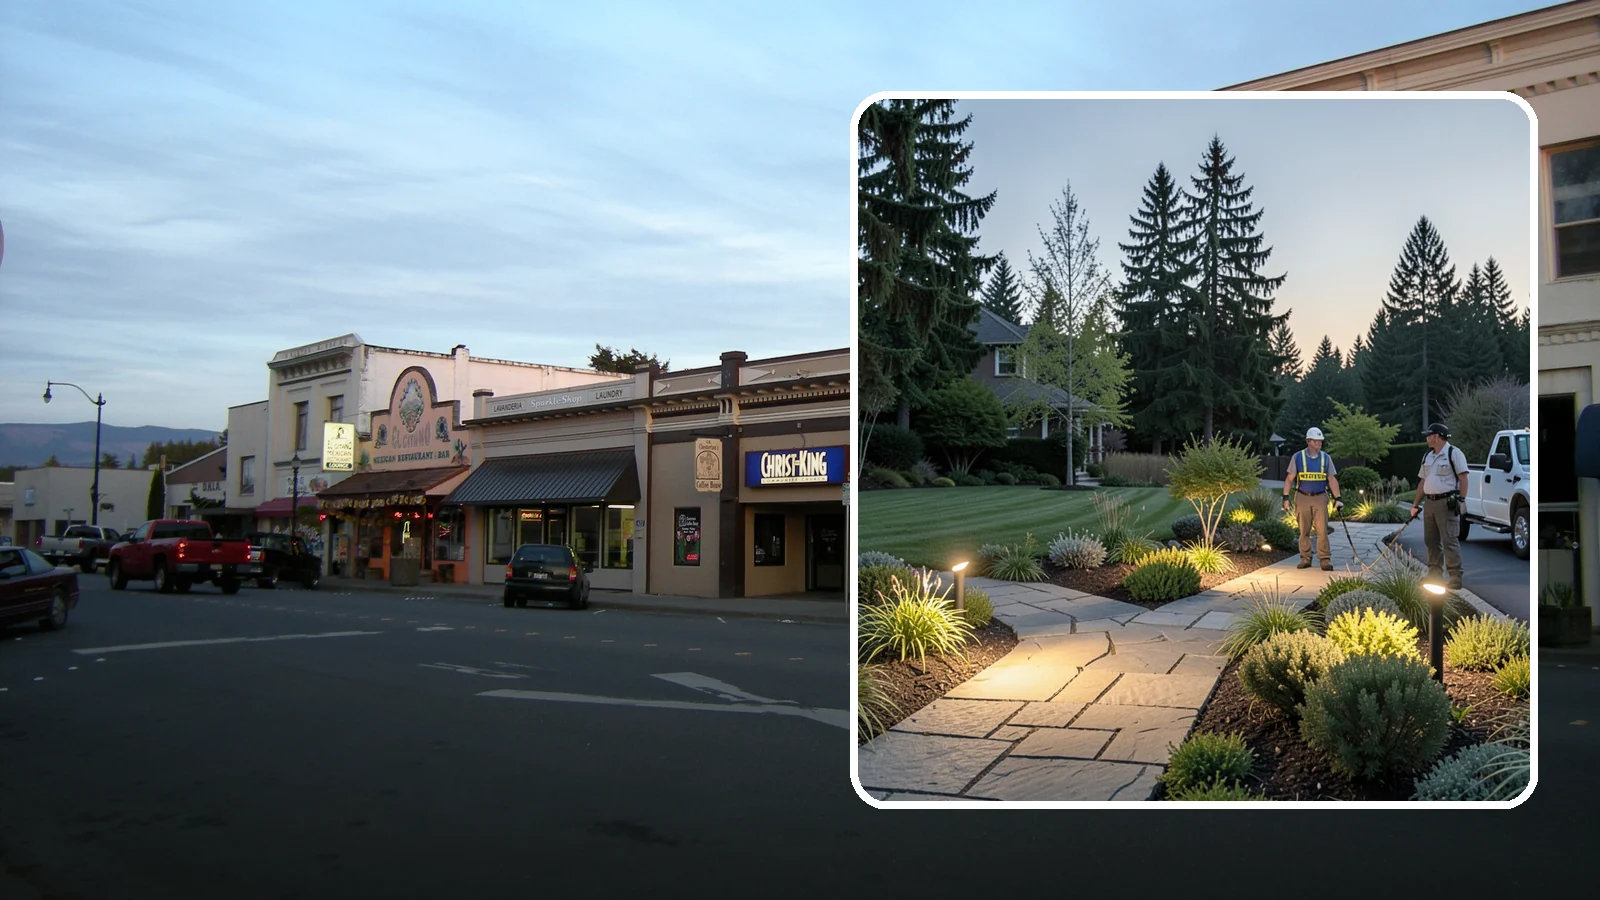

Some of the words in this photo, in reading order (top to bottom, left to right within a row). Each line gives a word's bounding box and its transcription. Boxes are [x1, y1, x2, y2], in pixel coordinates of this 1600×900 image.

[531, 396, 561, 408] Sparkle
[562, 394, 582, 405] Shop
[595, 389, 623, 400] LAUNDRY
[493, 402, 523, 413] LAVANDERIA
[391, 425, 402, 449] EL
[373, 455, 396, 464] MEXICAN
[397, 451, 434, 462] RESTAURANT
[437, 450, 450, 459] BAR
[761, 452, 797, 478] CHRIST
[799, 450, 827, 476] KING
[696, 480, 709, 489] Coffee
[710, 480, 722, 489] House
